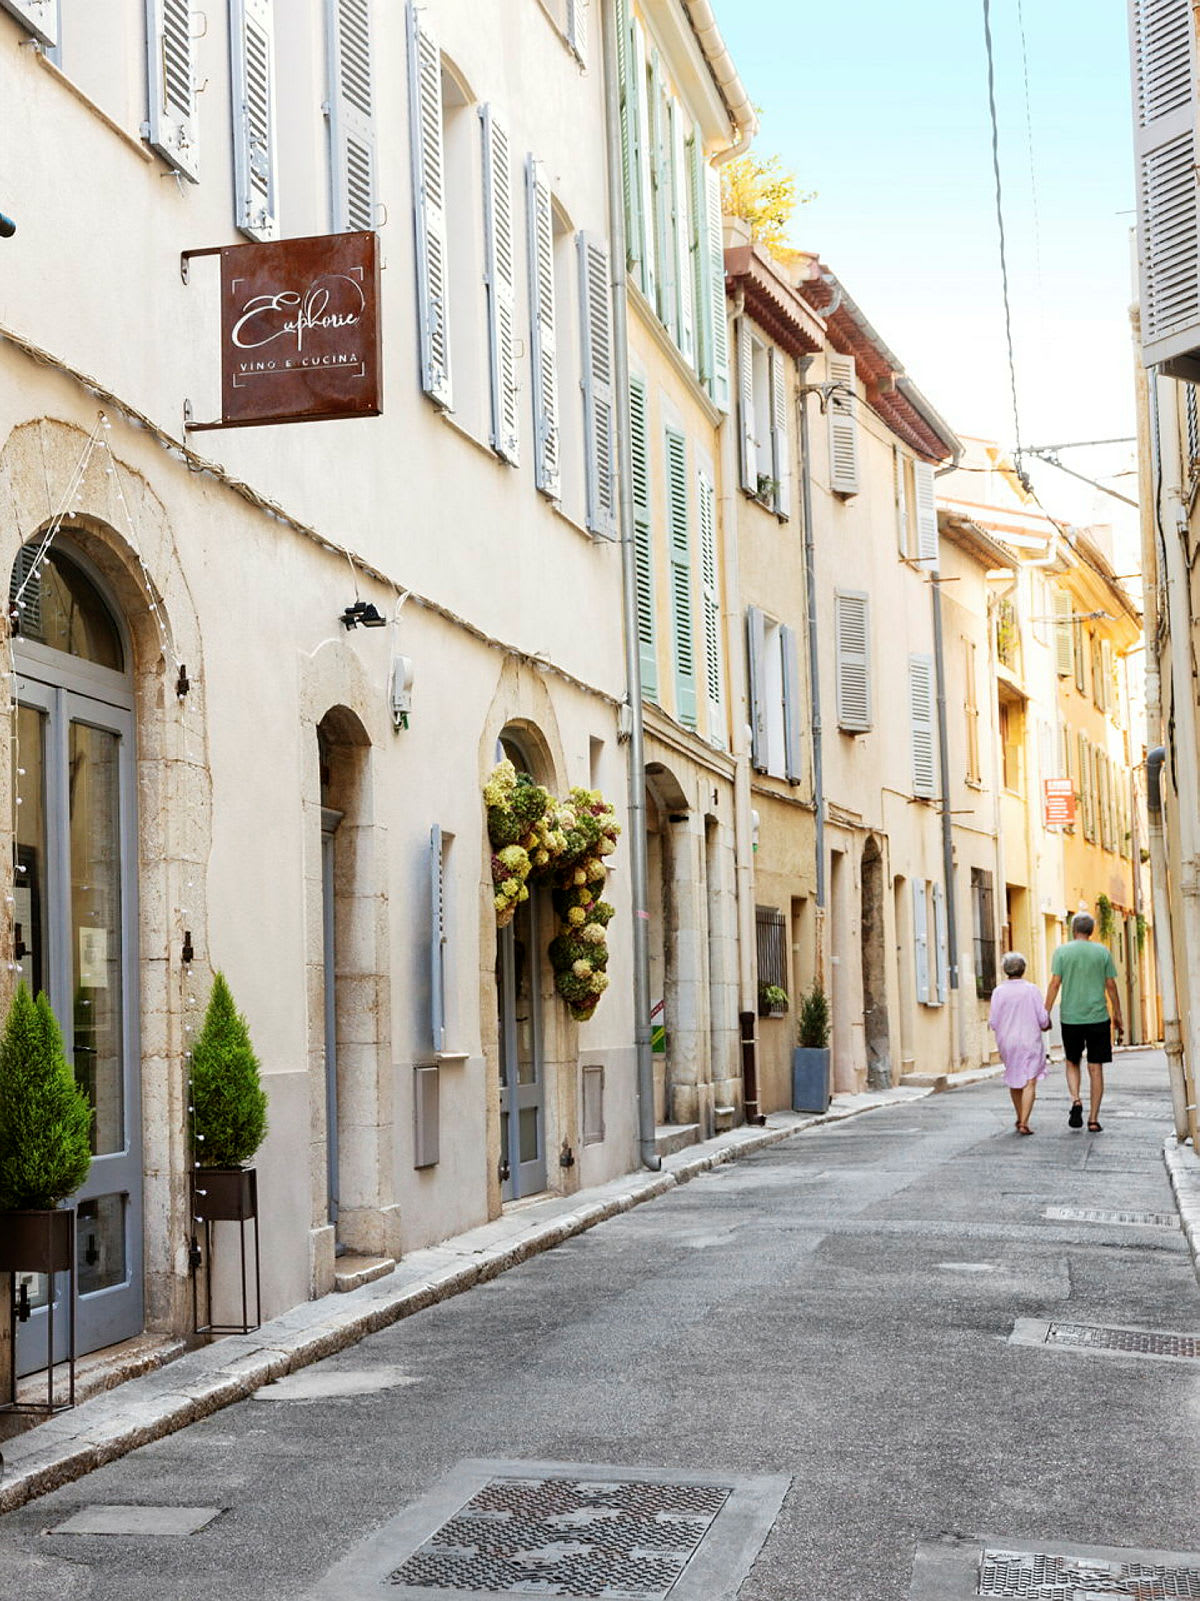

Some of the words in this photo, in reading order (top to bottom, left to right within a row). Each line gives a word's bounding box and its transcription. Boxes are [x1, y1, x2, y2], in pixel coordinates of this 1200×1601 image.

[232, 288, 360, 351] Euphorie
[240, 360, 276, 372] VINO
[285, 359, 293, 368] E
[302, 353, 358, 367] CUCINA
